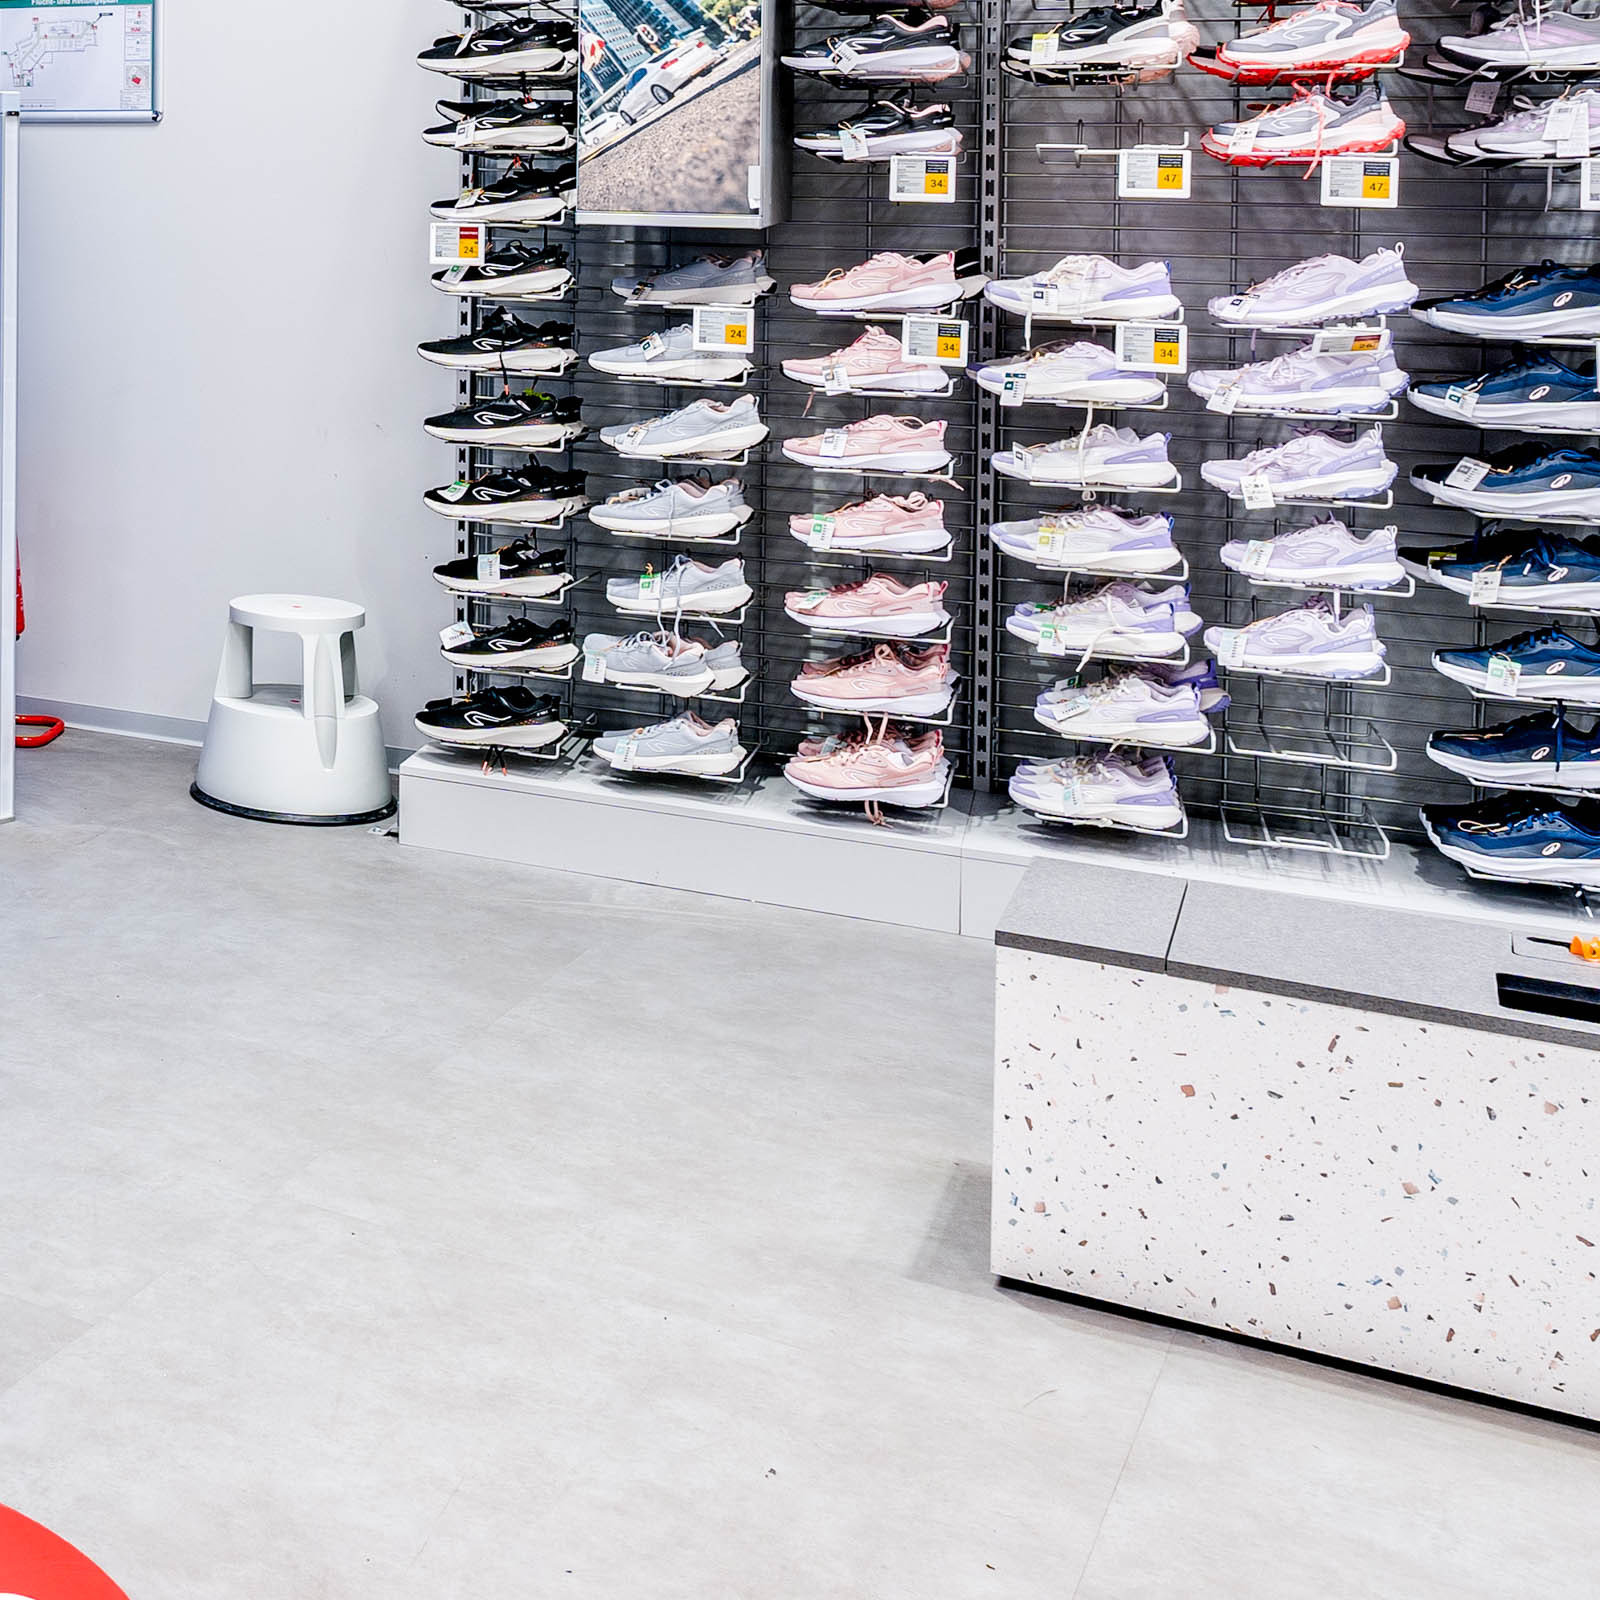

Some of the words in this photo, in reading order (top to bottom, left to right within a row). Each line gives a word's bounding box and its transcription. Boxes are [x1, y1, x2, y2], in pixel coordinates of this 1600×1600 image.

[1163, 174, 1177, 183] 47
[930, 179, 943, 188] 34
[1369, 182, 1384, 191] 47
[730, 329, 742, 338] 24
[943, 342, 955, 352] 34
